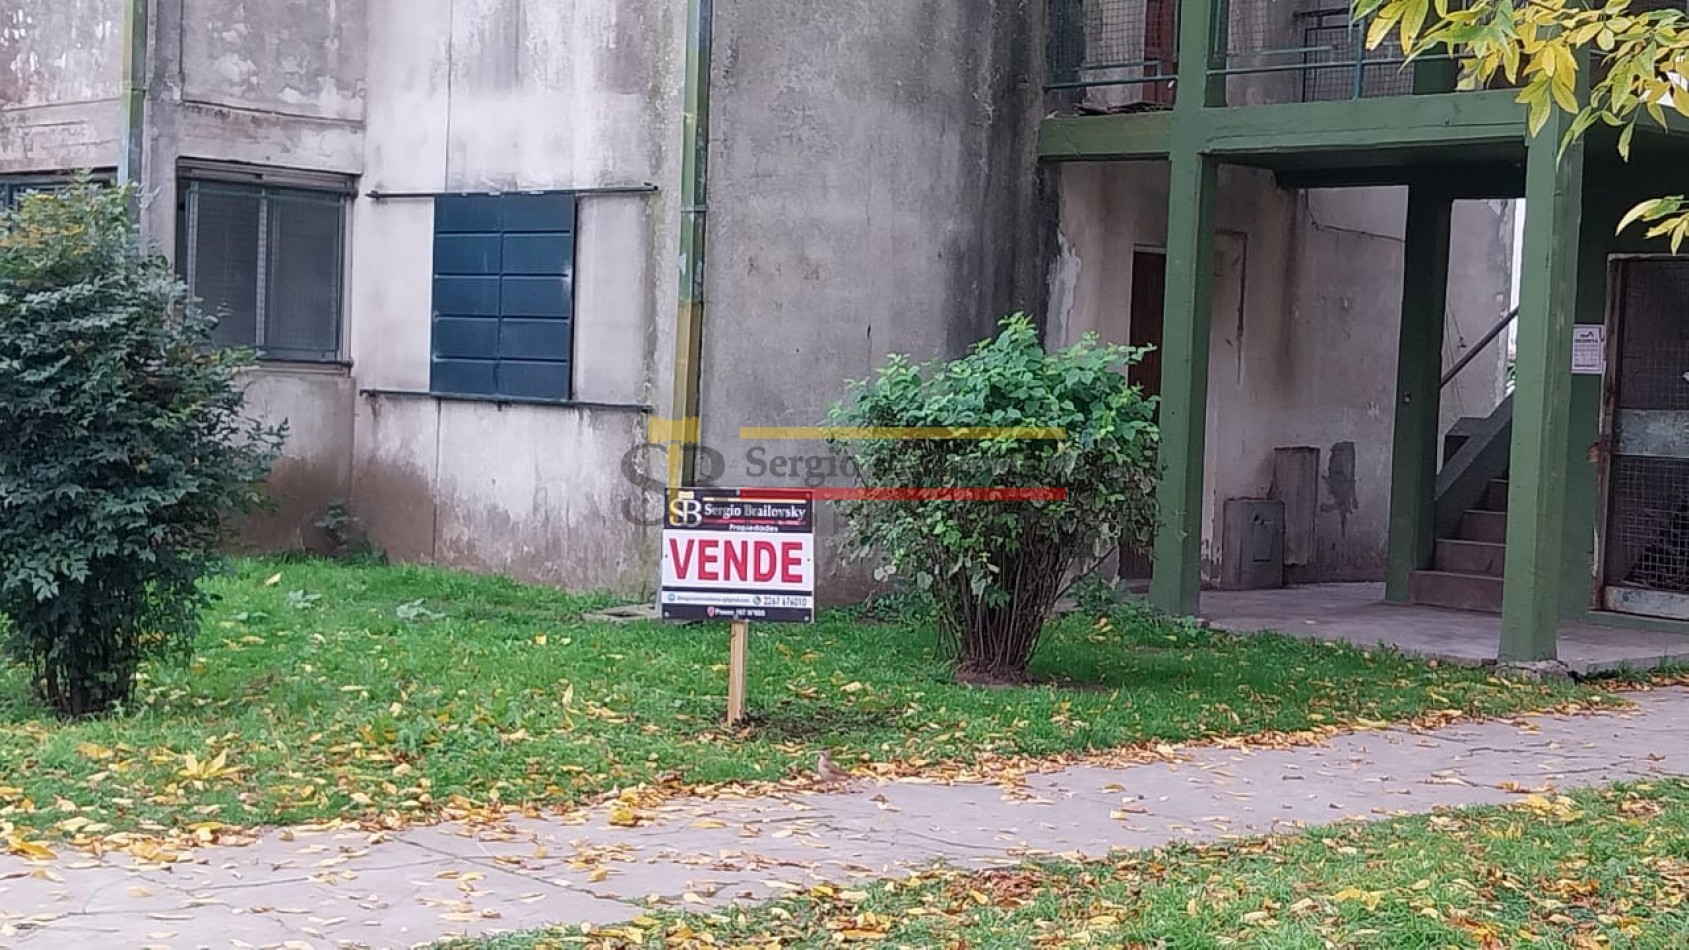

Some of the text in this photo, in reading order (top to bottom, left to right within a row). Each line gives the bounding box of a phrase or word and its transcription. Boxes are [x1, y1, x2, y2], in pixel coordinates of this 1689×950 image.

[704, 503, 806, 520] Sergio Brailovsky
[729, 524, 779, 532] Propiedades
[669, 538, 803, 584] VENDE
